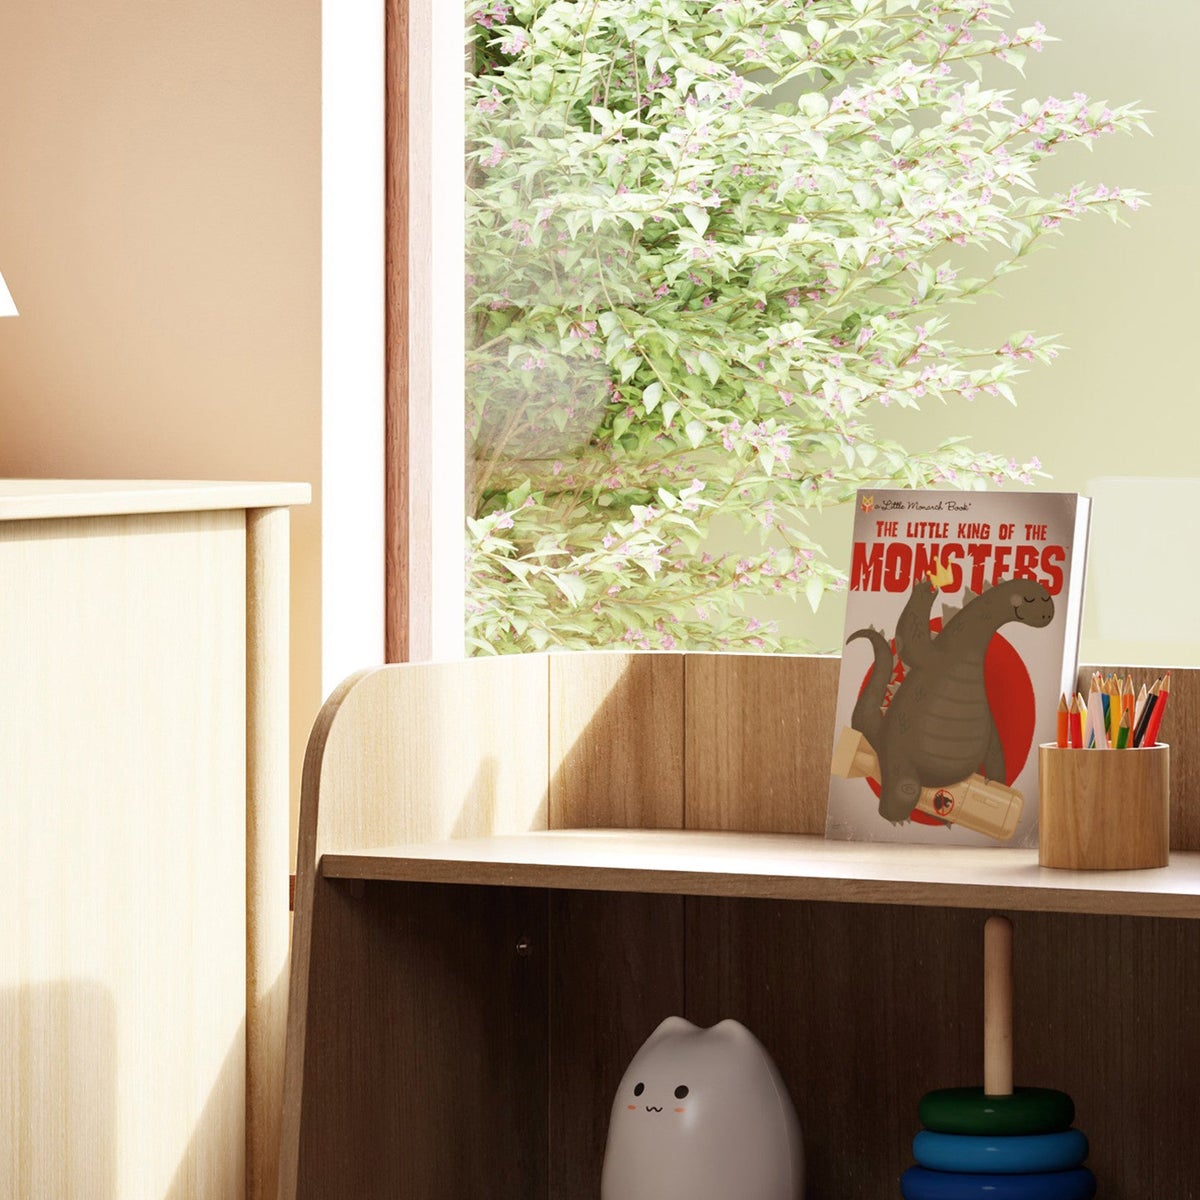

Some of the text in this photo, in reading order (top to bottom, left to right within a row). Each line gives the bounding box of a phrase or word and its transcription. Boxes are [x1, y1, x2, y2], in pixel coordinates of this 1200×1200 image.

[880, 500, 904, 511] Little
[907, 501, 943, 511] Monarch
[876, 521, 1047, 541] THE LITTLE KING OF THE
[850, 542, 1066, 596] MONSTERS
